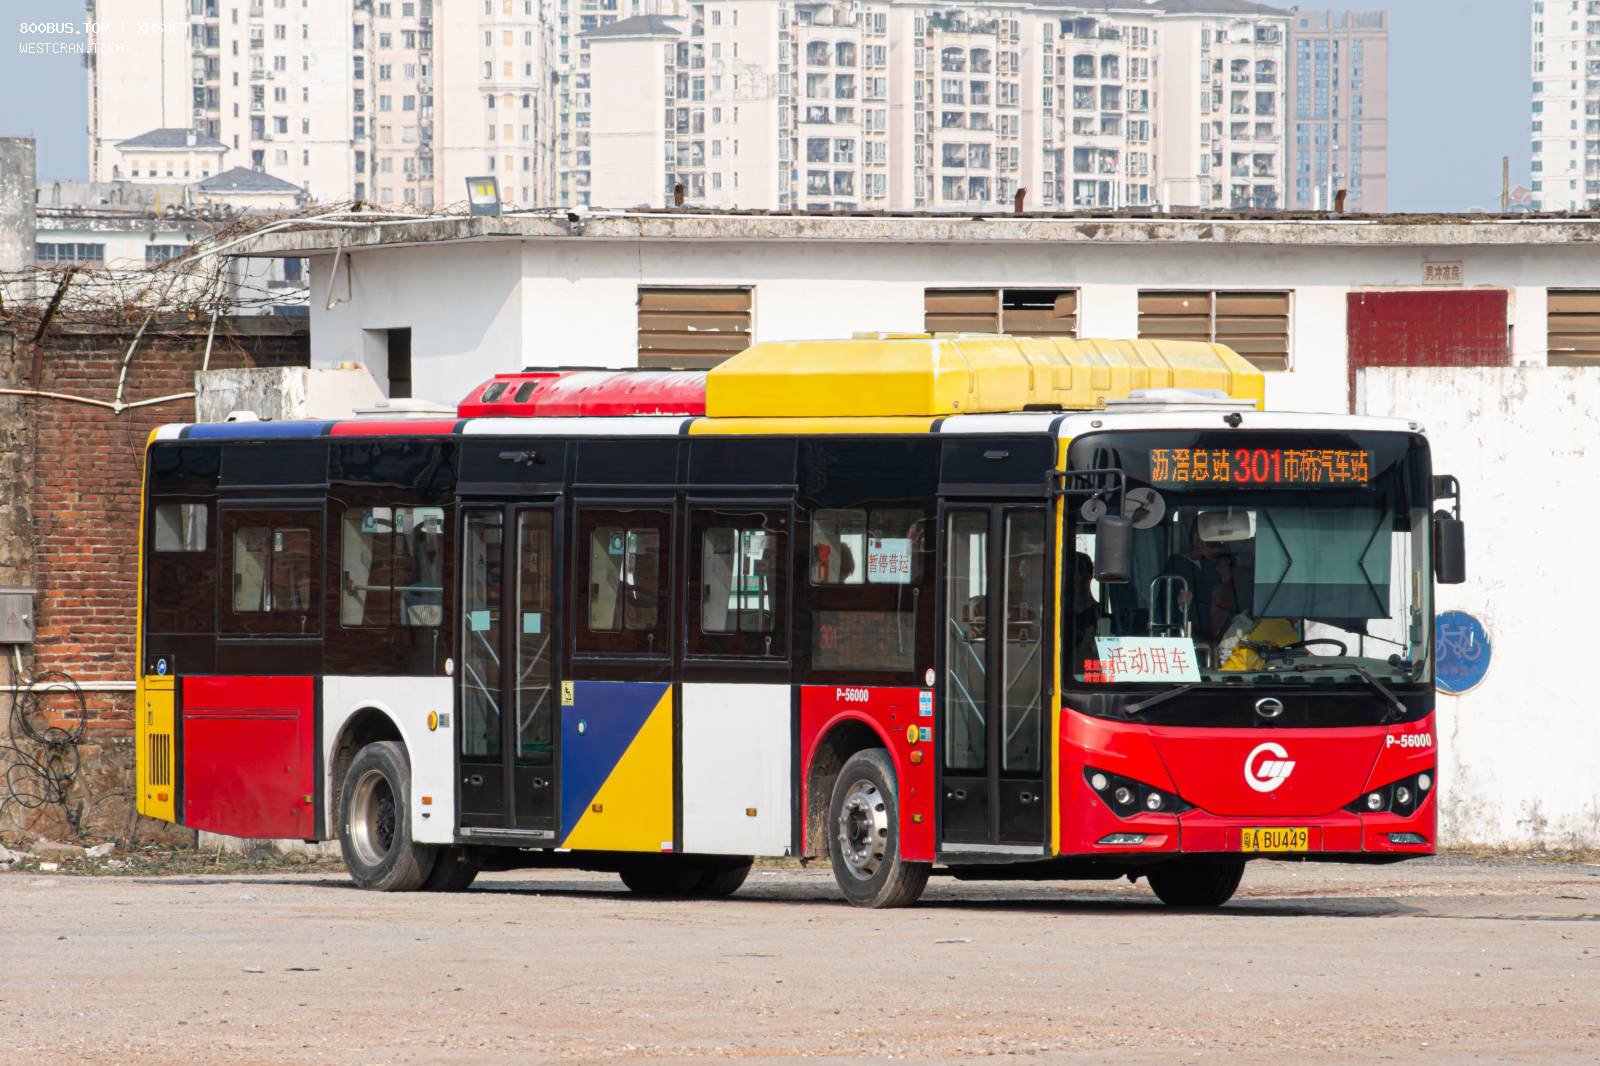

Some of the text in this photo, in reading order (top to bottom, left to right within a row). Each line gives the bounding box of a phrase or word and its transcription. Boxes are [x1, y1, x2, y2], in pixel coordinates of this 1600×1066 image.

[1233, 448, 1282, 484] 301
[1283, 449, 1369, 483] 市桥汽车站
[868, 553, 910, 574] 暂停营运
[1106, 646, 1191, 675] 活动用车
[836, 688, 869, 702] P-56000
[1386, 733, 1432, 749] P-56000
